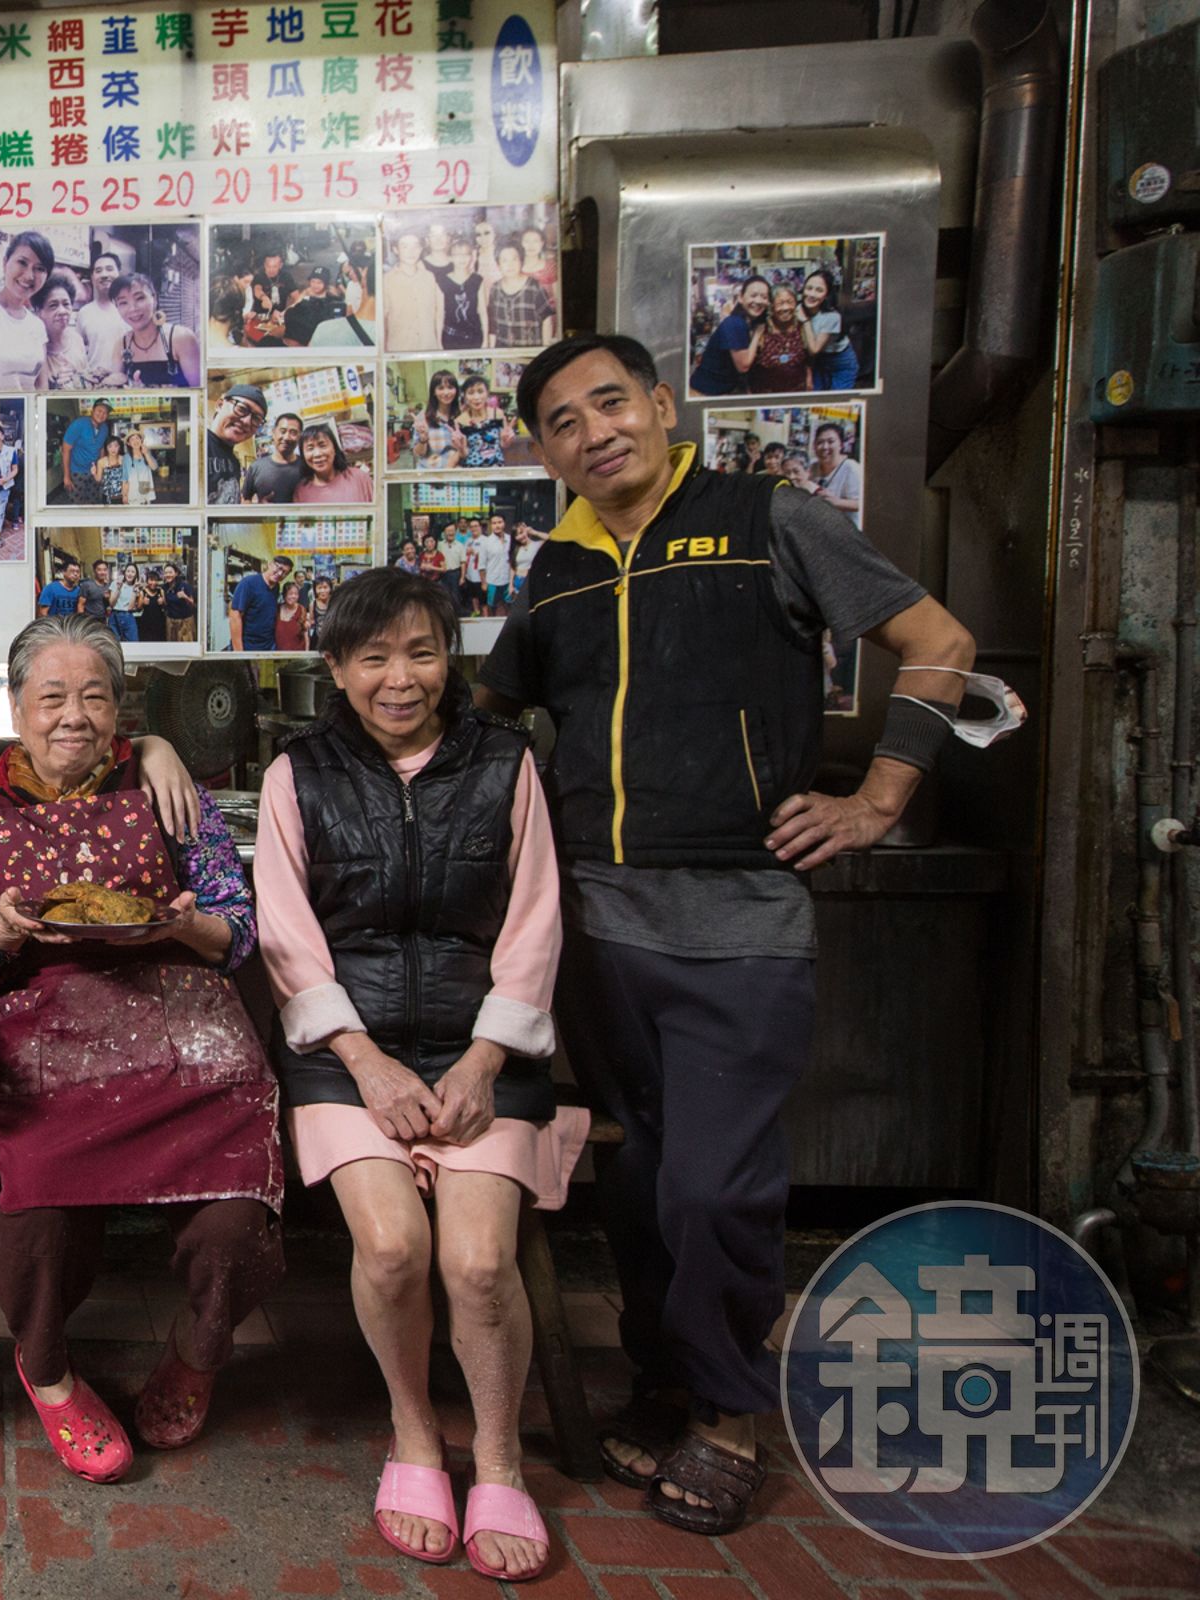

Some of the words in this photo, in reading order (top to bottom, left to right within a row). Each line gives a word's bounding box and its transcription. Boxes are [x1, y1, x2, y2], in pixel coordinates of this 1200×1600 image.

[155, 13, 195, 160] 粿炸
[211, 8, 251, 157] 芋頭炸
[266, 6, 305, 153] 地瓜炸
[321, 2, 360, 149] 豆腐炸
[375, 0, 415, 146] 花枝炸
[498, 44, 534, 141] 飲料
[47, 19, 88, 167] 網西蝦捲
[100, 177, 140, 212] 25
[153, 170, 194, 207] 20
[212, 167, 251, 204] 20
[267, 163, 304, 202] 15
[322, 161, 358, 198] 15
[433, 159, 471, 197] 20
[51, 180, 89, 216] 25
[666, 535, 729, 561] FBI
